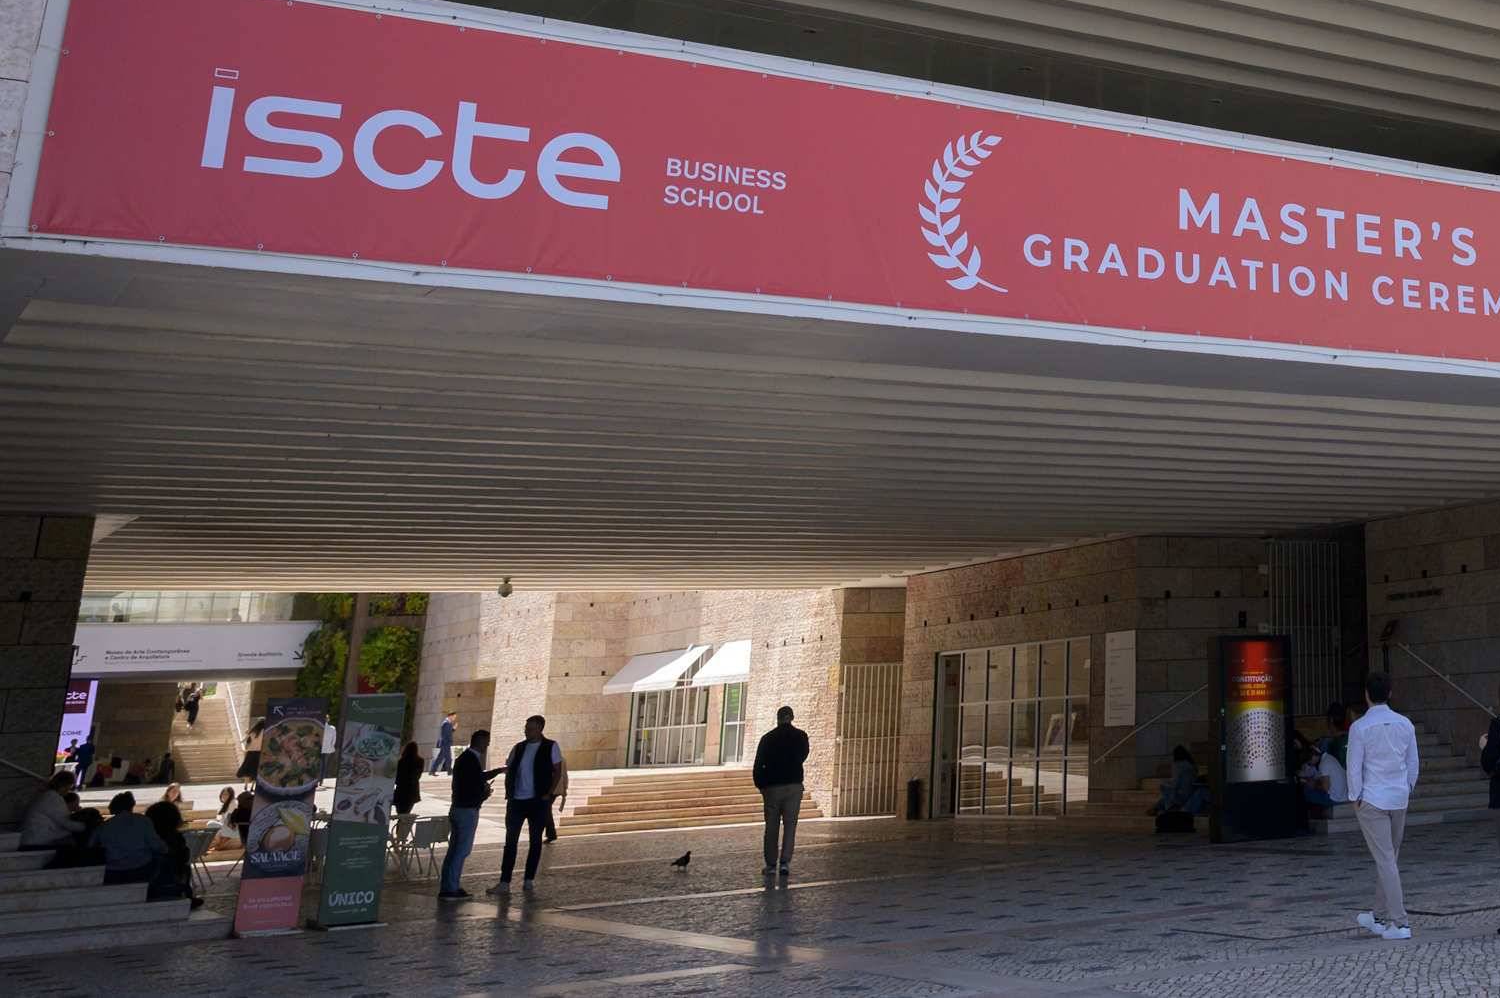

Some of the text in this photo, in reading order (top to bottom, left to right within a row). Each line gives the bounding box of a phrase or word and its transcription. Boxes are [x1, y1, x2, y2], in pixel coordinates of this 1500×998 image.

[201, 67, 621, 210] iscte
[666, 158, 787, 191] BUSINESS
[663, 185, 764, 215] SCHOOL
[1178, 188, 1478, 267] MASTER'S
[1023, 233, 1350, 301] GRADUATION
[328, 889, 375, 907] ÚNICO
